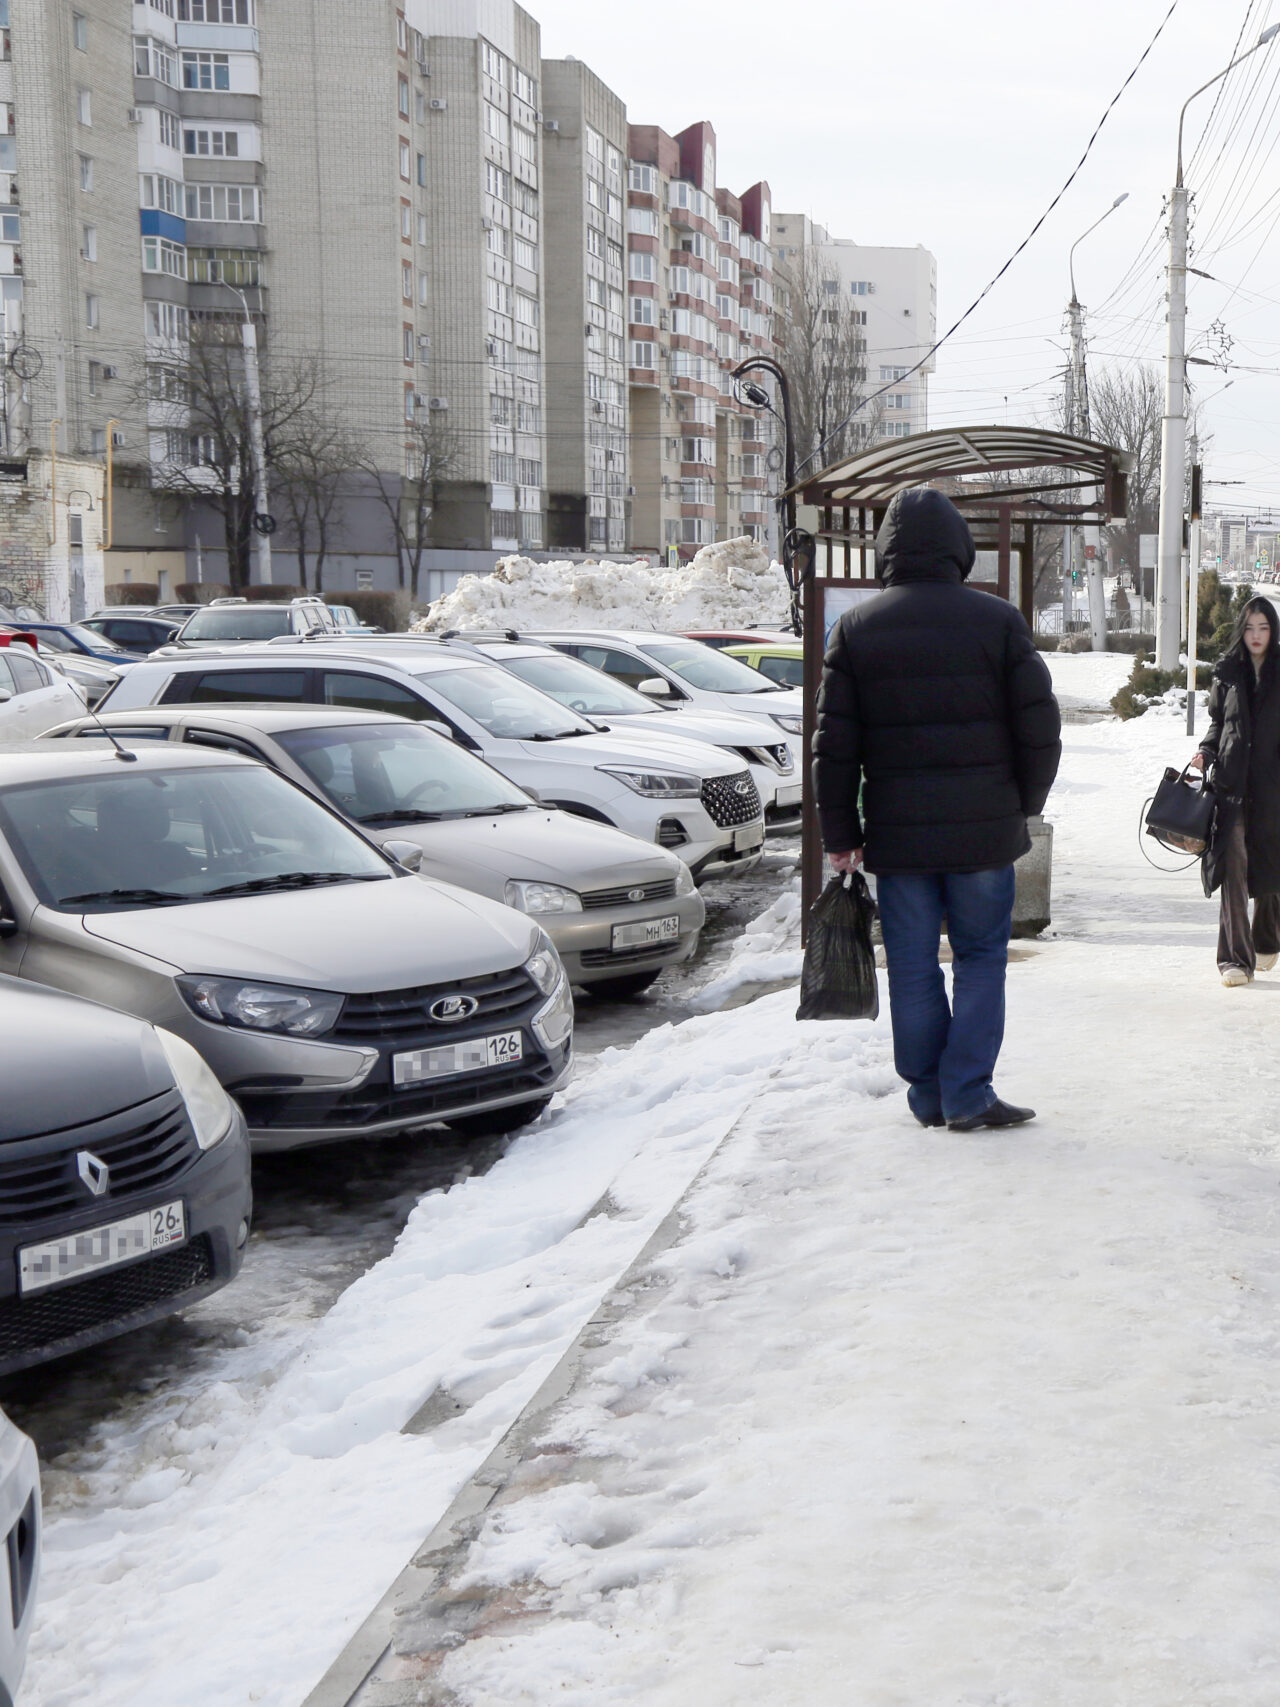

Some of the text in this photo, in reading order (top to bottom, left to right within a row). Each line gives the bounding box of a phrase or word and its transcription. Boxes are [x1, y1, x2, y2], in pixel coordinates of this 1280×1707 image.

[489, 1034, 517, 1056] 126
[495, 1053, 510, 1063] RUS
[153, 1206, 176, 1235] 26
[152, 1233, 170, 1247] RUS
